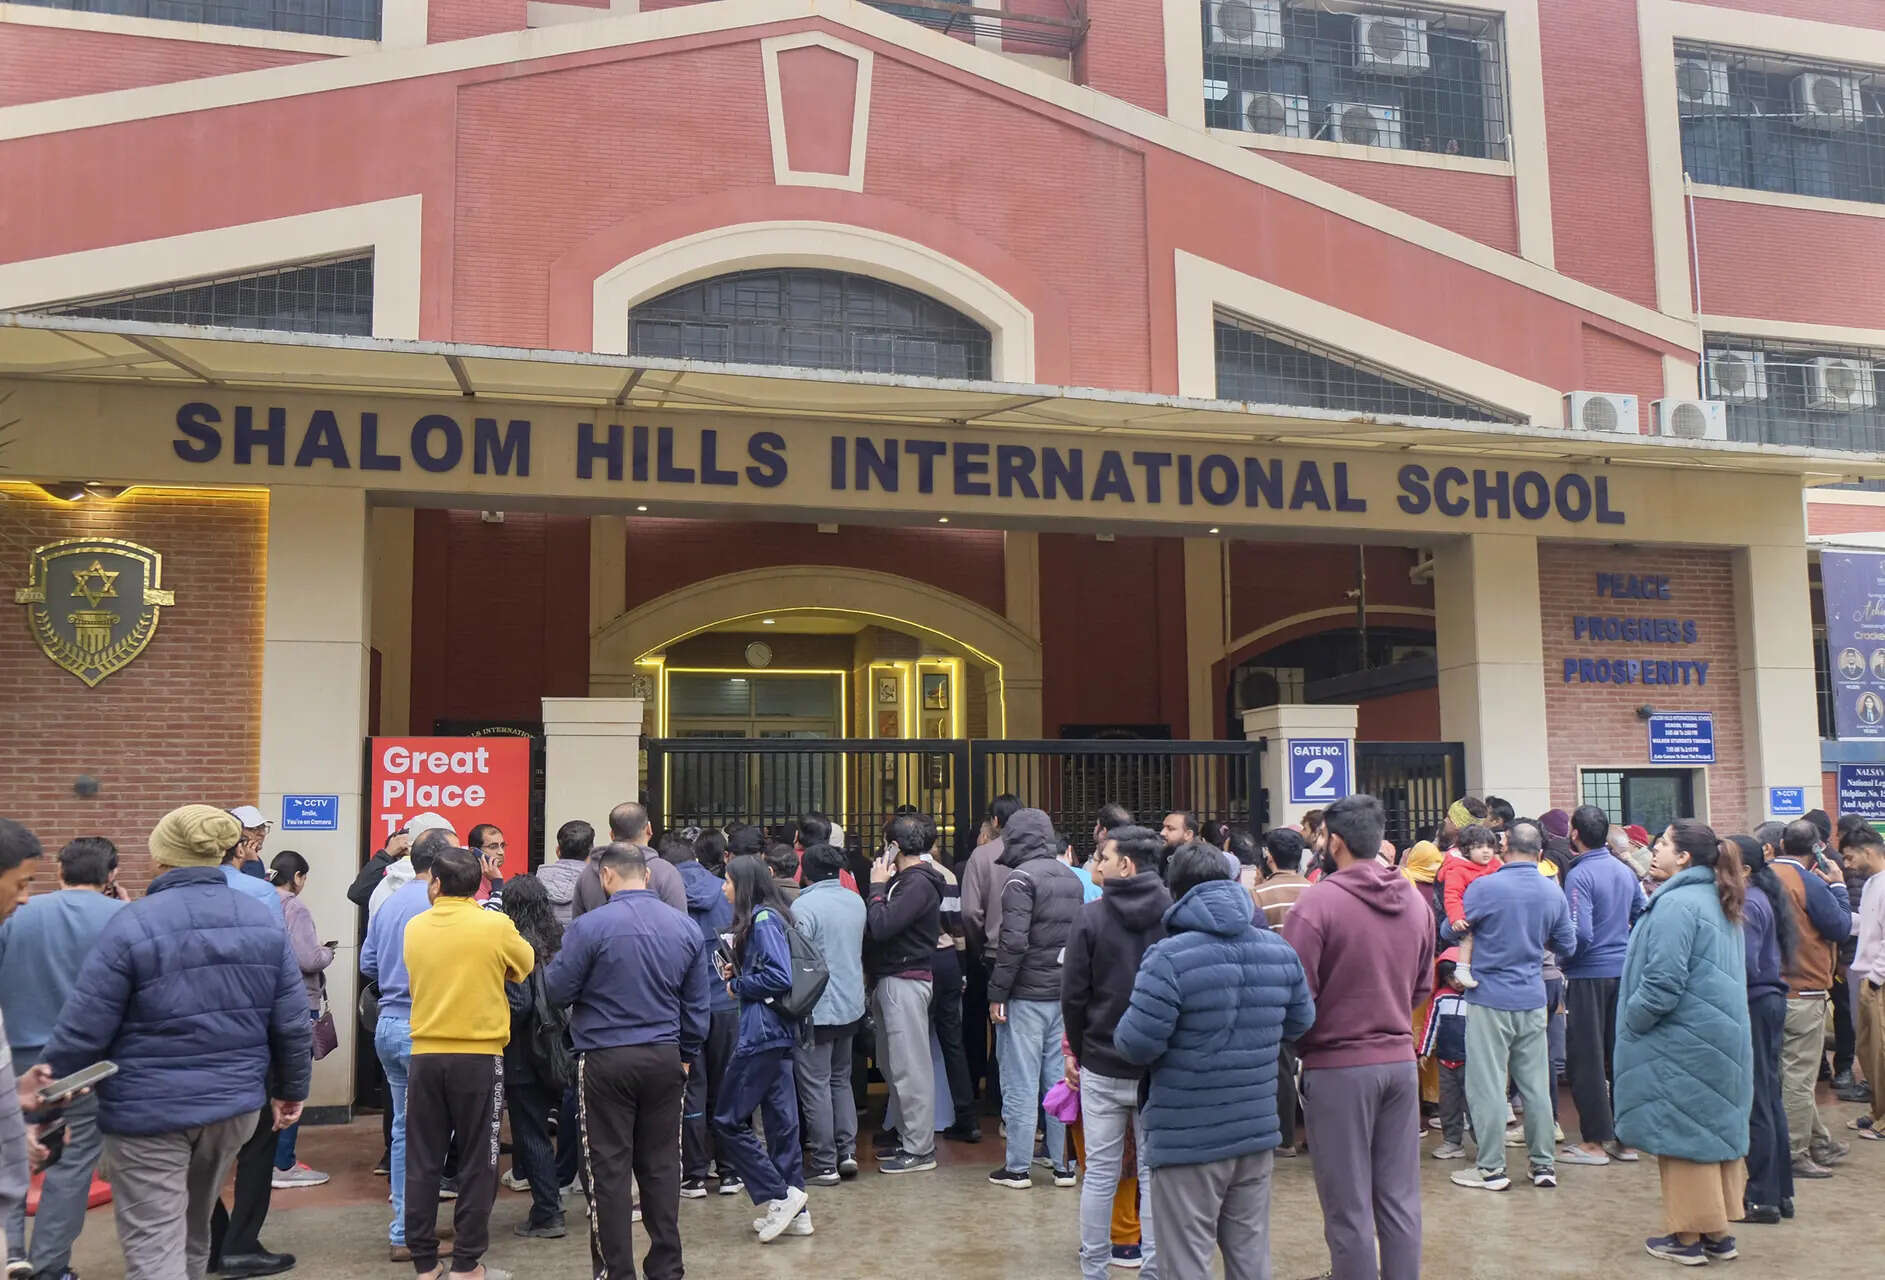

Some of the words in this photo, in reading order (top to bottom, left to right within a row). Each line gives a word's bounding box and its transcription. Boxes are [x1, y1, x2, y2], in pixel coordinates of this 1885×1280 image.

[173, 402, 531, 477] SHALOM
[577, 423, 788, 488] HILLS
[831, 436, 1367, 513] INTERNATIONAL
[1397, 464, 1625, 525] SCHOOL
[1596, 572, 1672, 600] PEACE
[1573, 616, 1698, 643] PROGRESS
[1563, 658, 1709, 686] PROSPERITY
[383, 746, 489, 774] Great
[1294, 746, 1322, 756] GATE
[1322, 746, 1342, 756] NO.
[1304, 758, 1336, 796] 2
[303, 799, 328, 807] CCTV
[383, 779, 486, 807] Place
[1841, 789, 1867, 799] Helpline
[1857, 801, 1875, 809] Apply
